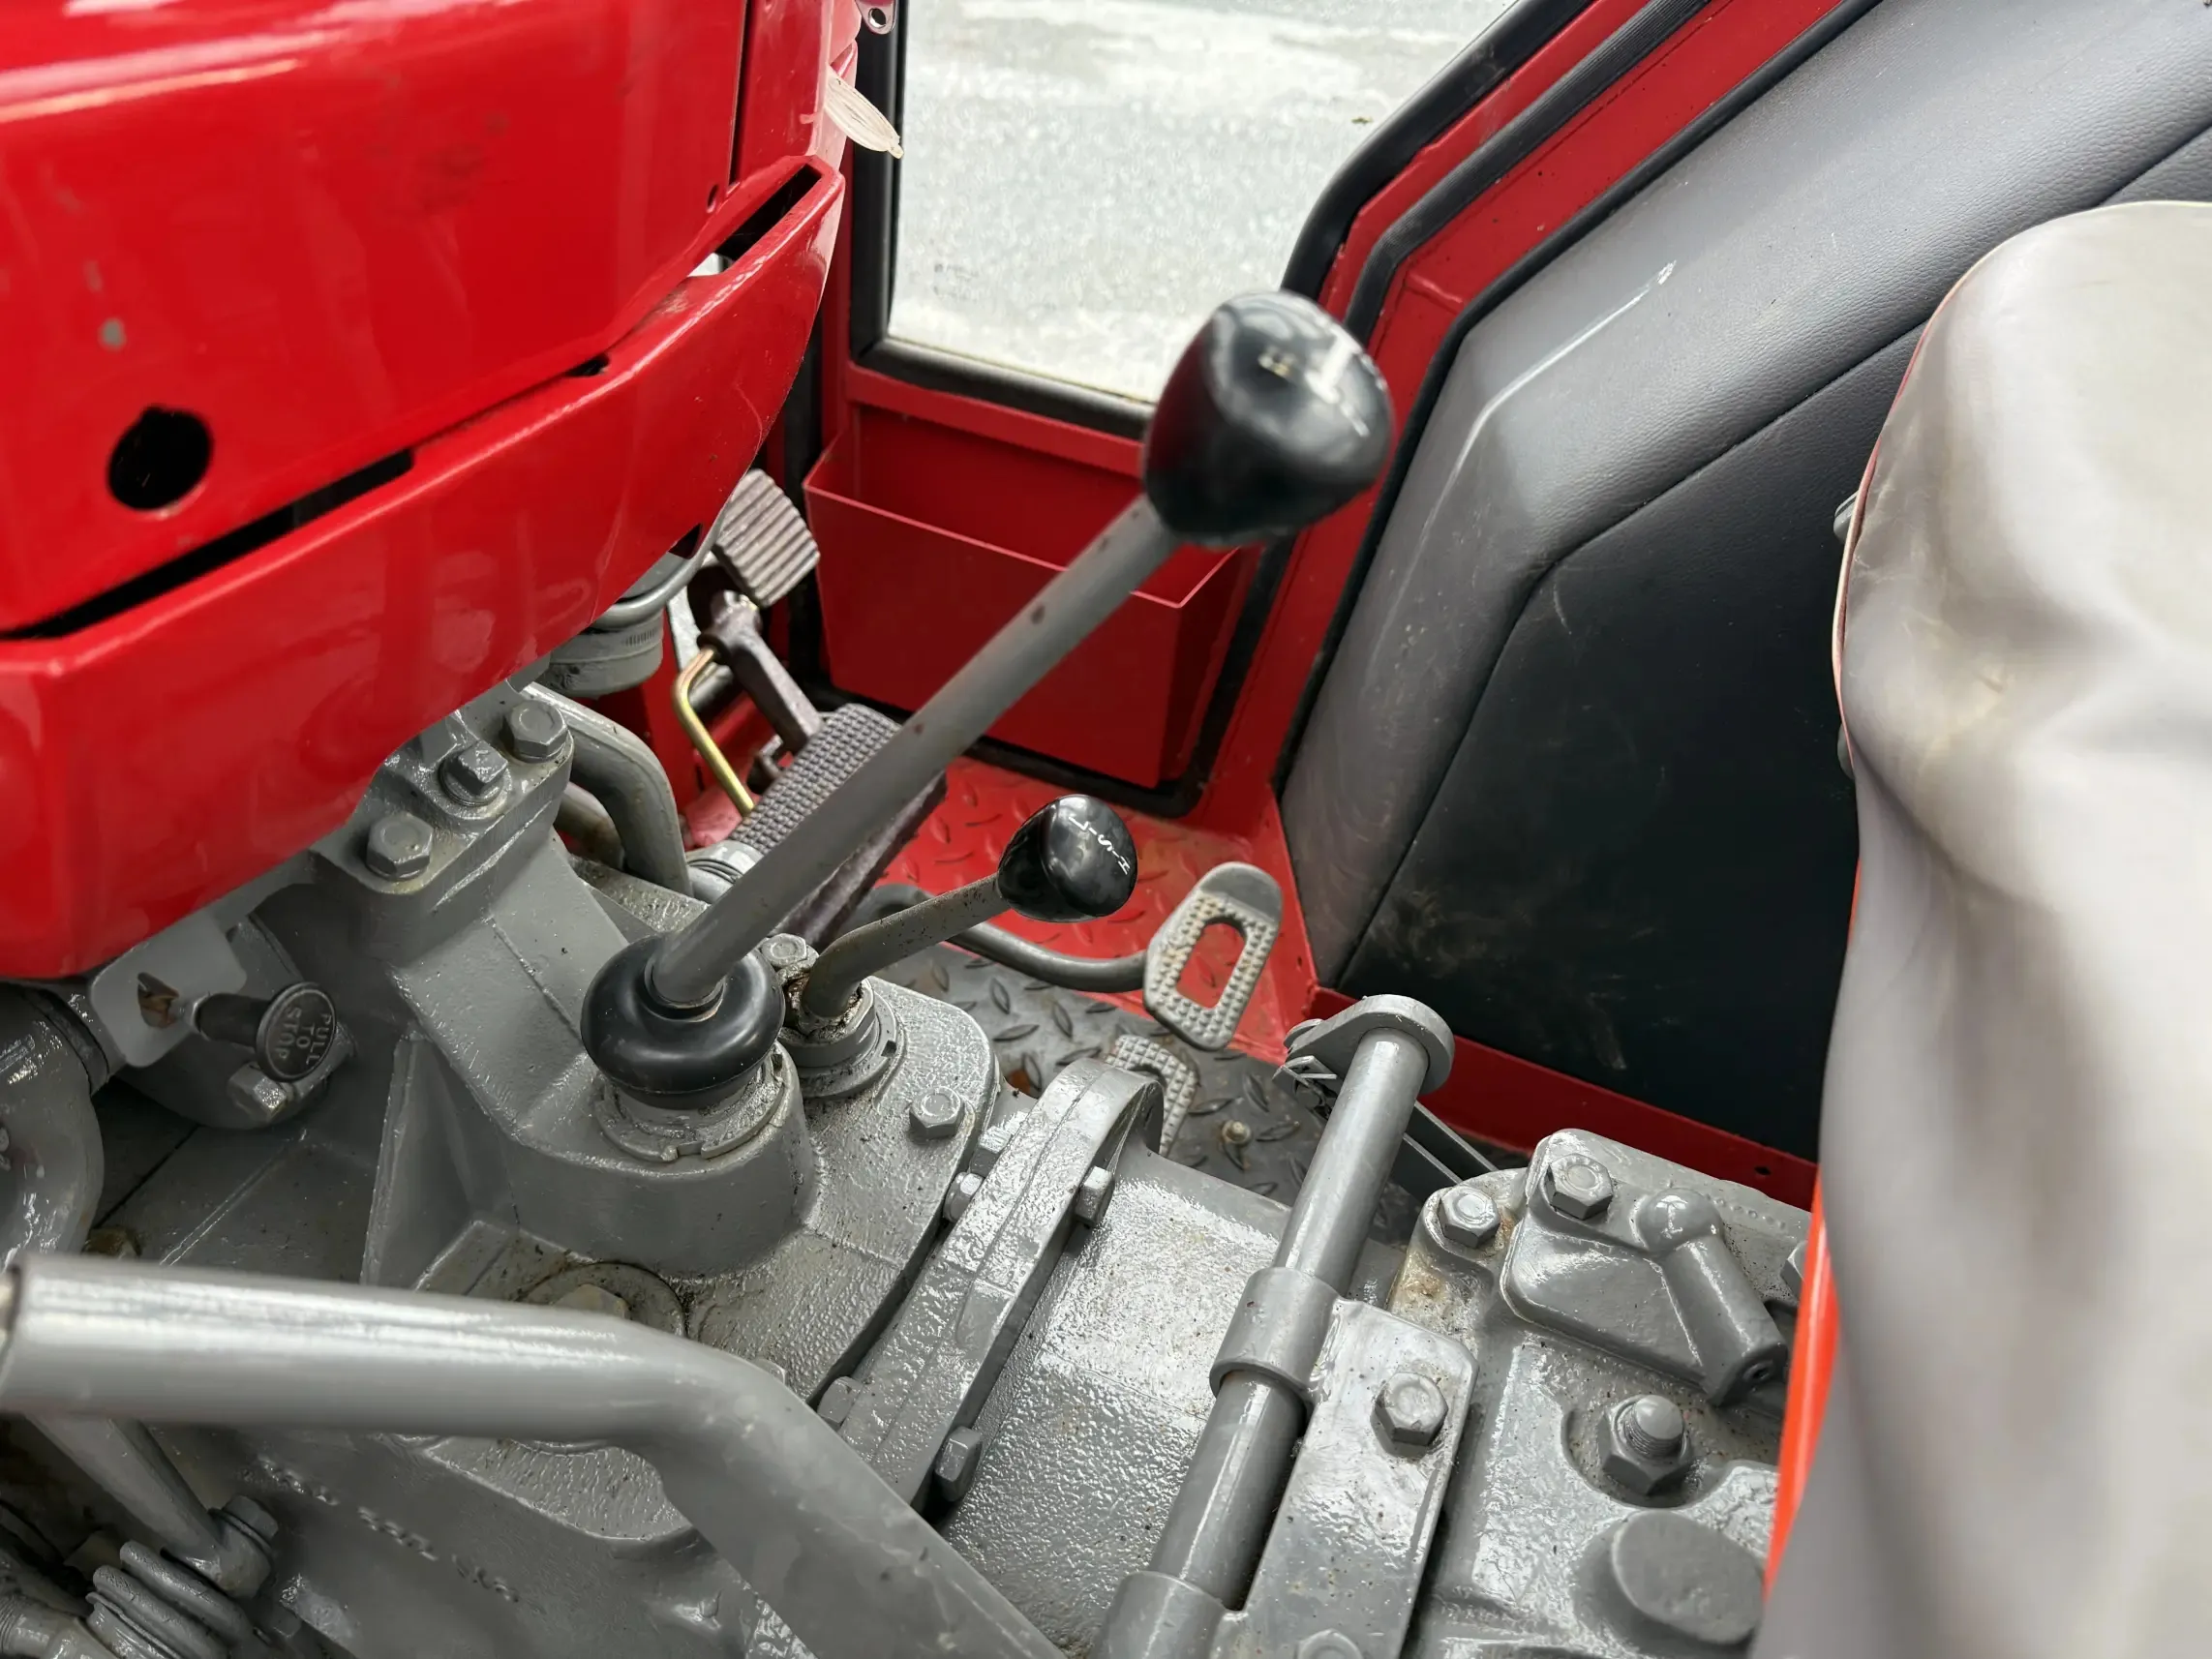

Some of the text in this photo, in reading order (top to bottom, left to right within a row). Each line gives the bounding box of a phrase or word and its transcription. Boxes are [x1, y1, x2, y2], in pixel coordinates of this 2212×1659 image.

[274, 1007, 303, 1060] STOP
[296, 1021, 316, 1049] TO
[305, 1012, 332, 1065] PULL
